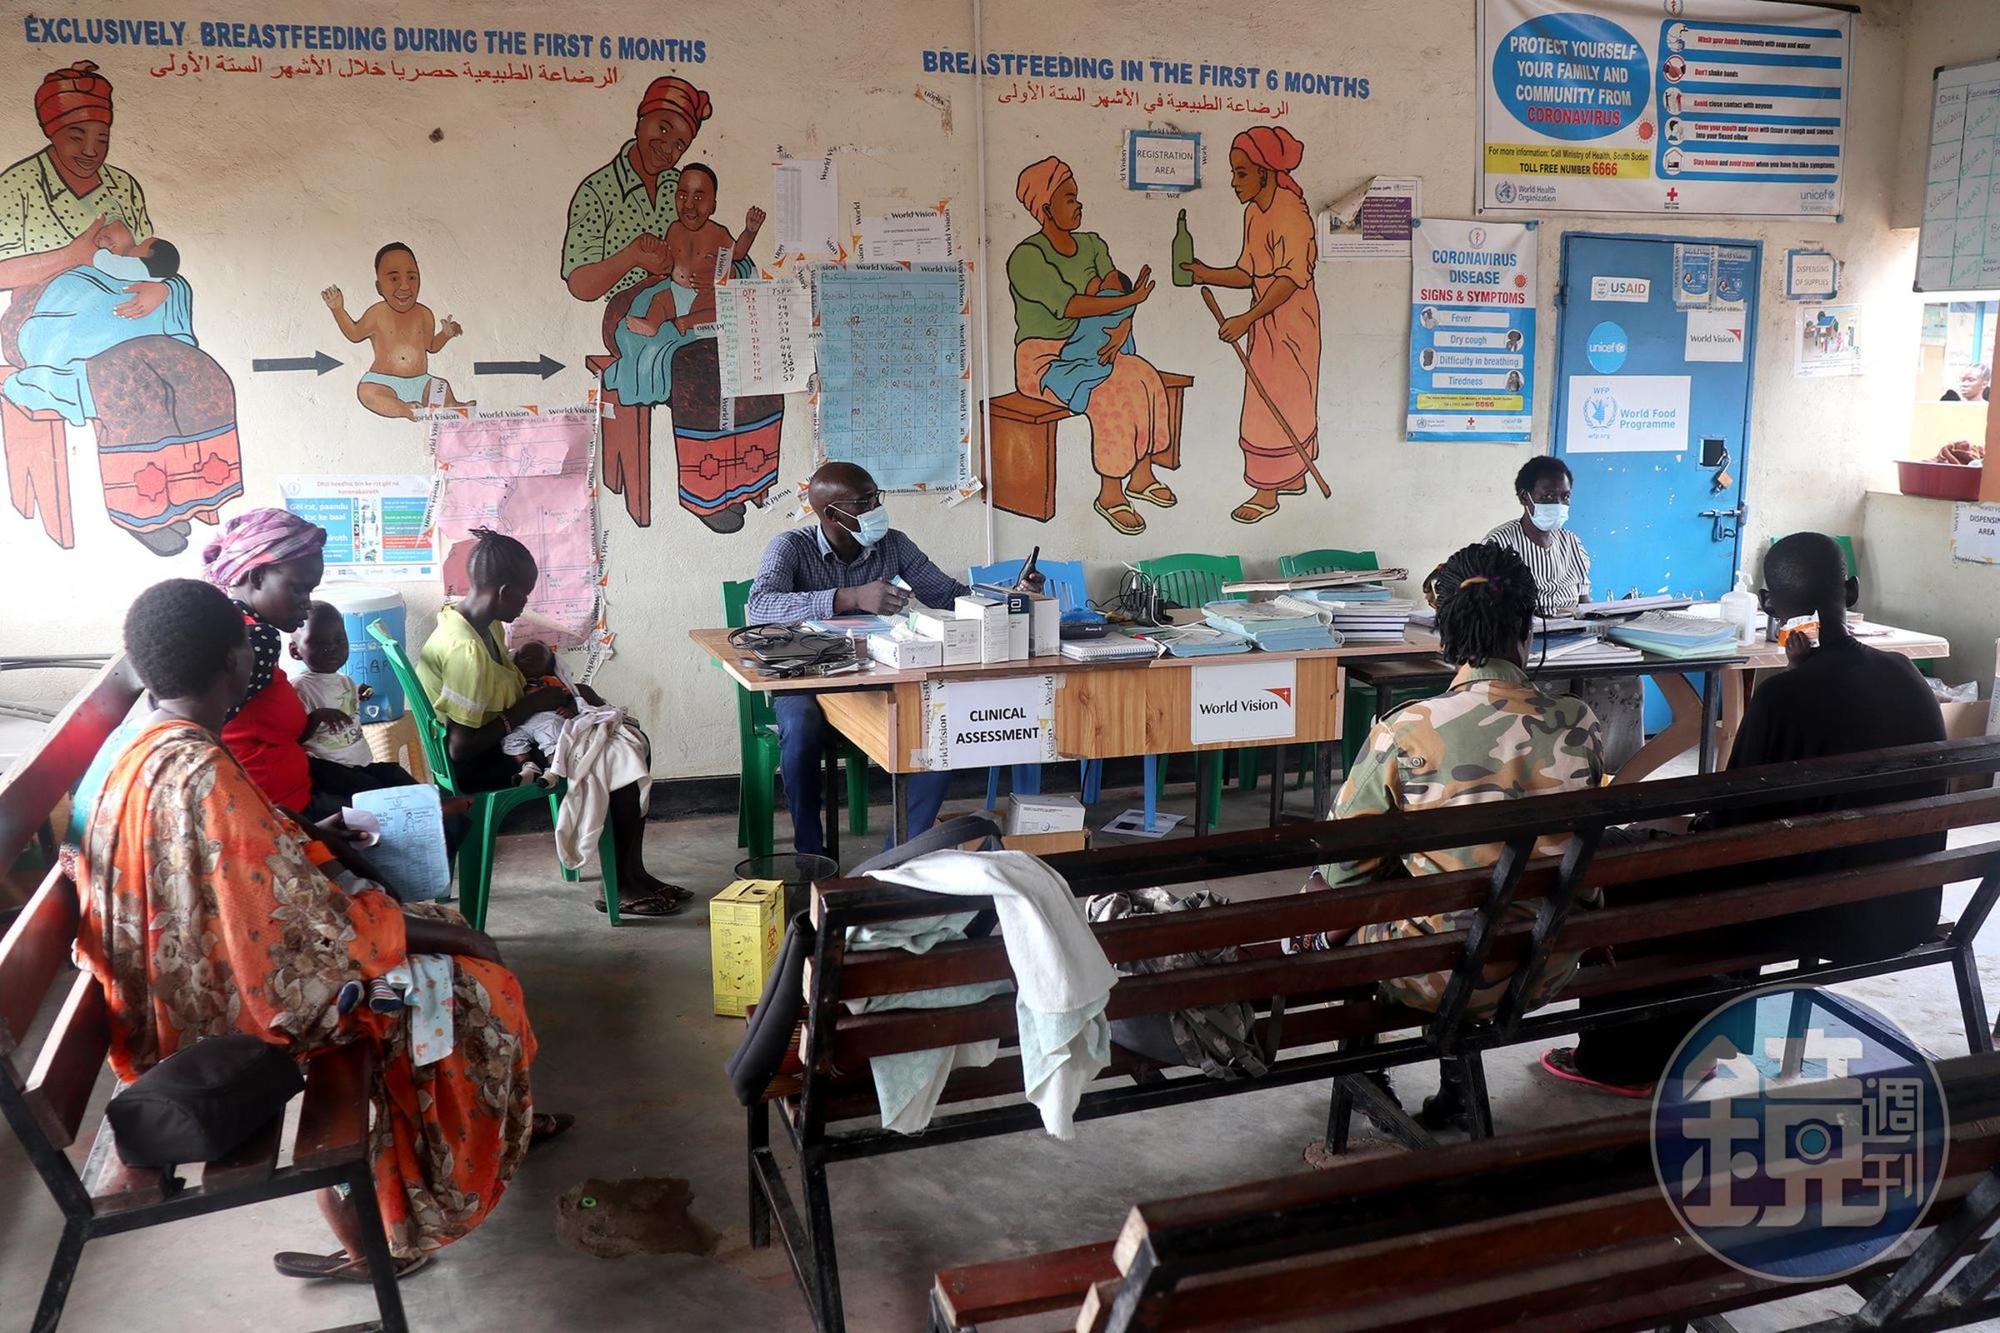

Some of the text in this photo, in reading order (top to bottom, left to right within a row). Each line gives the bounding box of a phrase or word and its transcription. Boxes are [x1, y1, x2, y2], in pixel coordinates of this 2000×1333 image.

[24, 17, 706, 64] EXCLUSIVELY BREASTFEEDING DURING THE FIRST 6 MONTHS
[1724, 37, 1739, 45] hands
[1740, 38, 1765, 47] frequently
[1510, 36, 1637, 60] PROTECT YOURSELF
[150, 50, 210, 78] الأولى
[215, 53, 262, 74] الستة
[270, 53, 331, 79] الأشهر
[338, 58, 386, 79] خلال
[462, 60, 532, 83] الطبيعية
[538, 63, 618, 88] الرضاعة
[923, 50, 1370, 100] BREASTFEEDING IN THE FIRST 6 MONTHS
[1517, 60, 1628, 83] YOUR FAMILY AND
[998, 80, 1289, 118] الرضاعة الطبيعية في الأشهر الستة الأولى
[1516, 84, 1632, 106] COMMUNITY FROM
[1528, 106, 1621, 126] CORONAVIRUS
[1695, 123, 1709, 131] Cover
[1710, 124, 1721, 132] your
[1137, 150, 1193, 160] REGISTRATION
[1488, 146, 1499, 155] For
[1563, 150, 1584, 160] Ministry
[1585, 150, 1592, 159] of
[1613, 151, 1630, 160] South
[1631, 153, 1648, 161] Sudan
[820, 158, 832, 181] World
[1520, 162, 1617, 176] TOLL FREE NUMBER 6666
[1693, 159, 1705, 167] Stay
[1154, 166, 1176, 175] AREA
[1518, 185, 1556, 194] World Health
[1800, 190, 1828, 200] unicef
[1518, 194, 1556, 203] Organization
[853, 201, 862, 225] World
[891, 210, 937, 219] World Vision
[1432, 250, 1517, 267] CORONAVIRUS
[880, 263, 903, 271] Vision
[1449, 270, 1500, 285] DISEASE
[1610, 282, 1647, 294] USAID
[1420, 289, 1525, 304] SIGNS & SYMPTOMS
[1451, 313, 1472, 323] Fever
[1450, 335, 1487, 346] Dry cough
[1690, 334, 1735, 343] World Vision
[1589, 343, 1615, 353] unicef
[1439, 355, 1519, 368] Difficulty in breathing
[1449, 376, 1483, 386] Tiredness
[434, 413, 460, 421] Vision
[479, 410, 530, 419] World Vision
[549, 406, 597, 415] World Vision
[1620, 408, 1676, 418] World Food
[1619, 419, 1676, 430] Programme
[1978, 528, 1995, 536] AREA
[1199, 698, 1278, 715] World Vision
[969, 707, 1027, 722] CLINICAL
[956, 727, 1039, 744] ASSESSMENT
